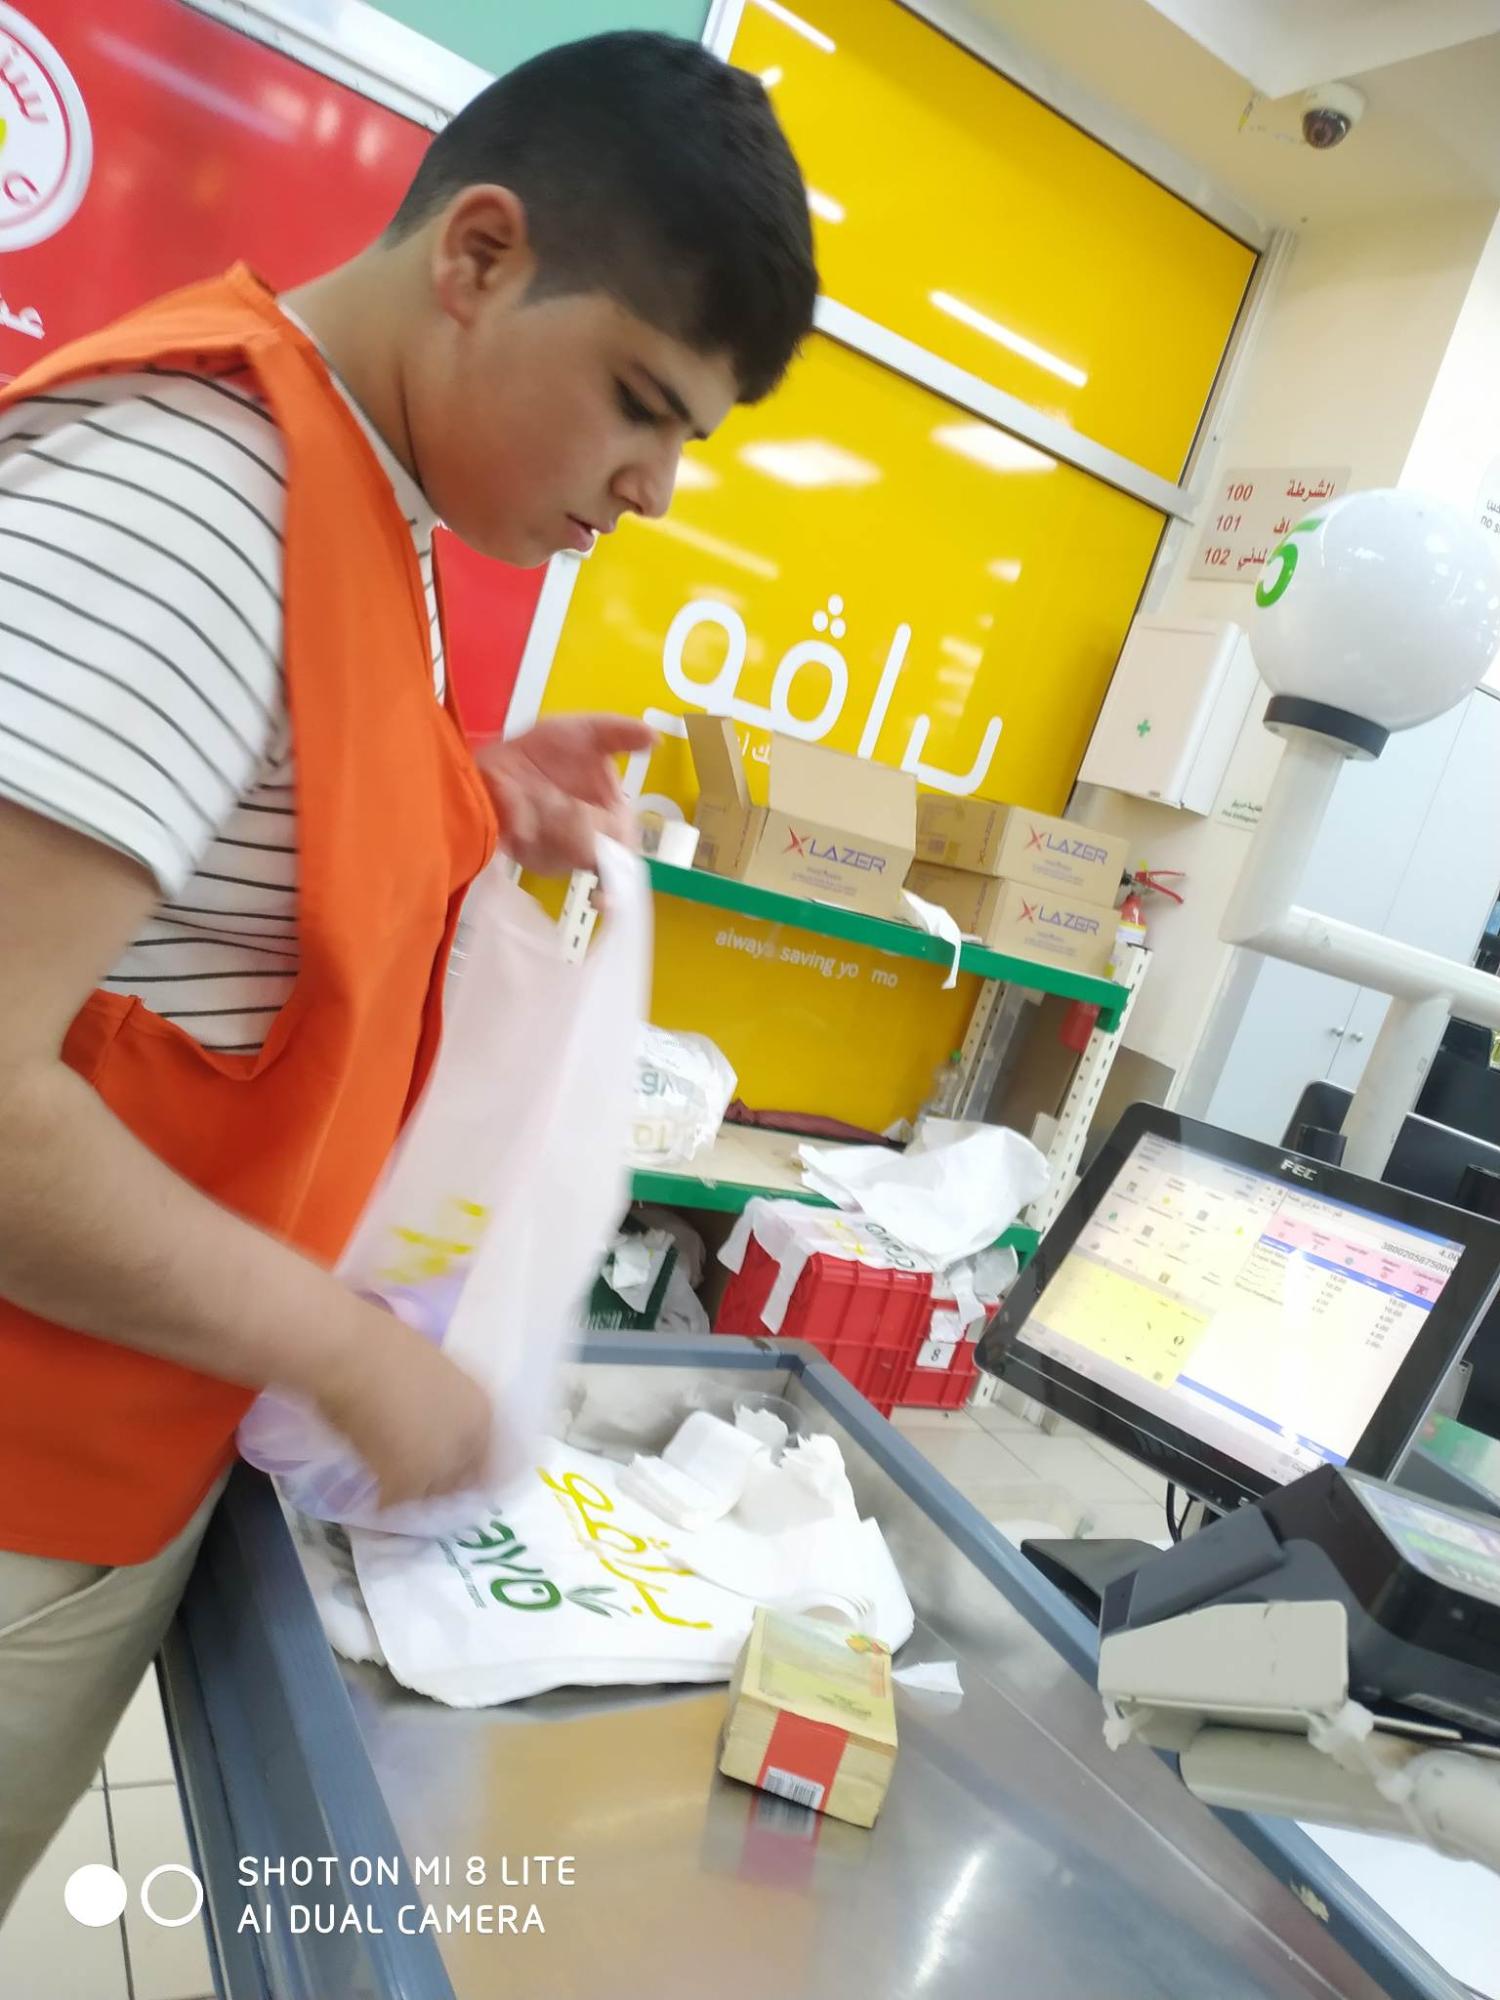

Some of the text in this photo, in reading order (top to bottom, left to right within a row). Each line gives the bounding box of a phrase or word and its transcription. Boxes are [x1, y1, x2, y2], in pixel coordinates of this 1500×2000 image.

[1226, 484, 1254, 501] 100
[1286, 479, 1336, 503] الشرطة
[1216, 514, 1242, 533] 101
[1204, 547, 1231, 566] 102
[780, 945, 836, 978] saving
[1280, 1158, 1319, 1181] FEC
